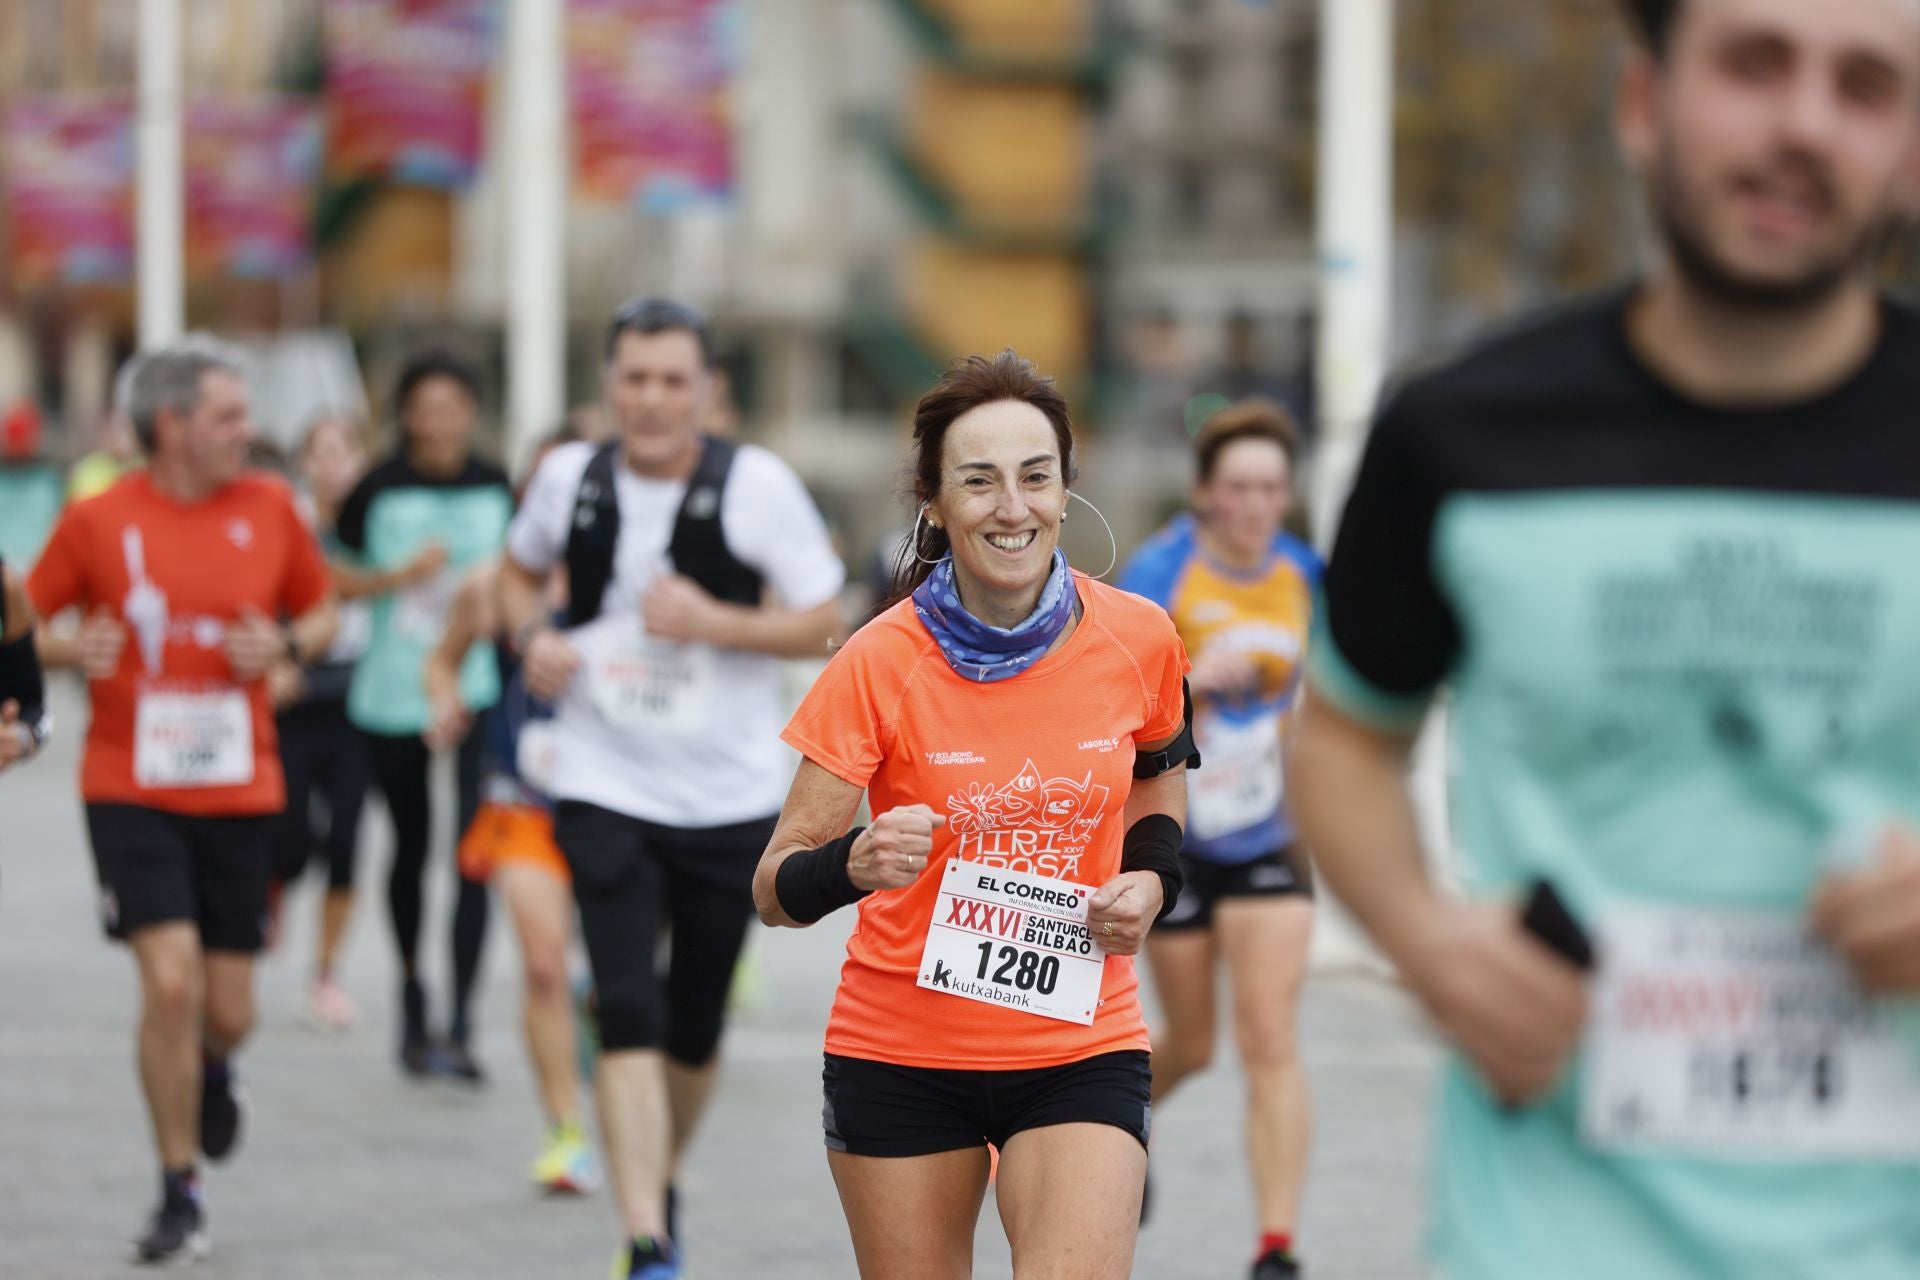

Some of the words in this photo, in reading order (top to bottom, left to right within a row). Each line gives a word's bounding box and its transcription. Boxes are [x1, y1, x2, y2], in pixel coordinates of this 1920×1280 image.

[1078, 739, 1112, 750] LABORAL
[958, 829, 1065, 857] HIRI
[977, 876, 999, 893] EL
[1003, 881, 1079, 909] CORREO
[946, 897, 1022, 940] XXXVI
[1052, 906, 1066, 916] CON
[1064, 908, 1083, 919] VALOR
[976, 940, 1060, 996] 1280
[952, 976, 1030, 1008] kutxabank
